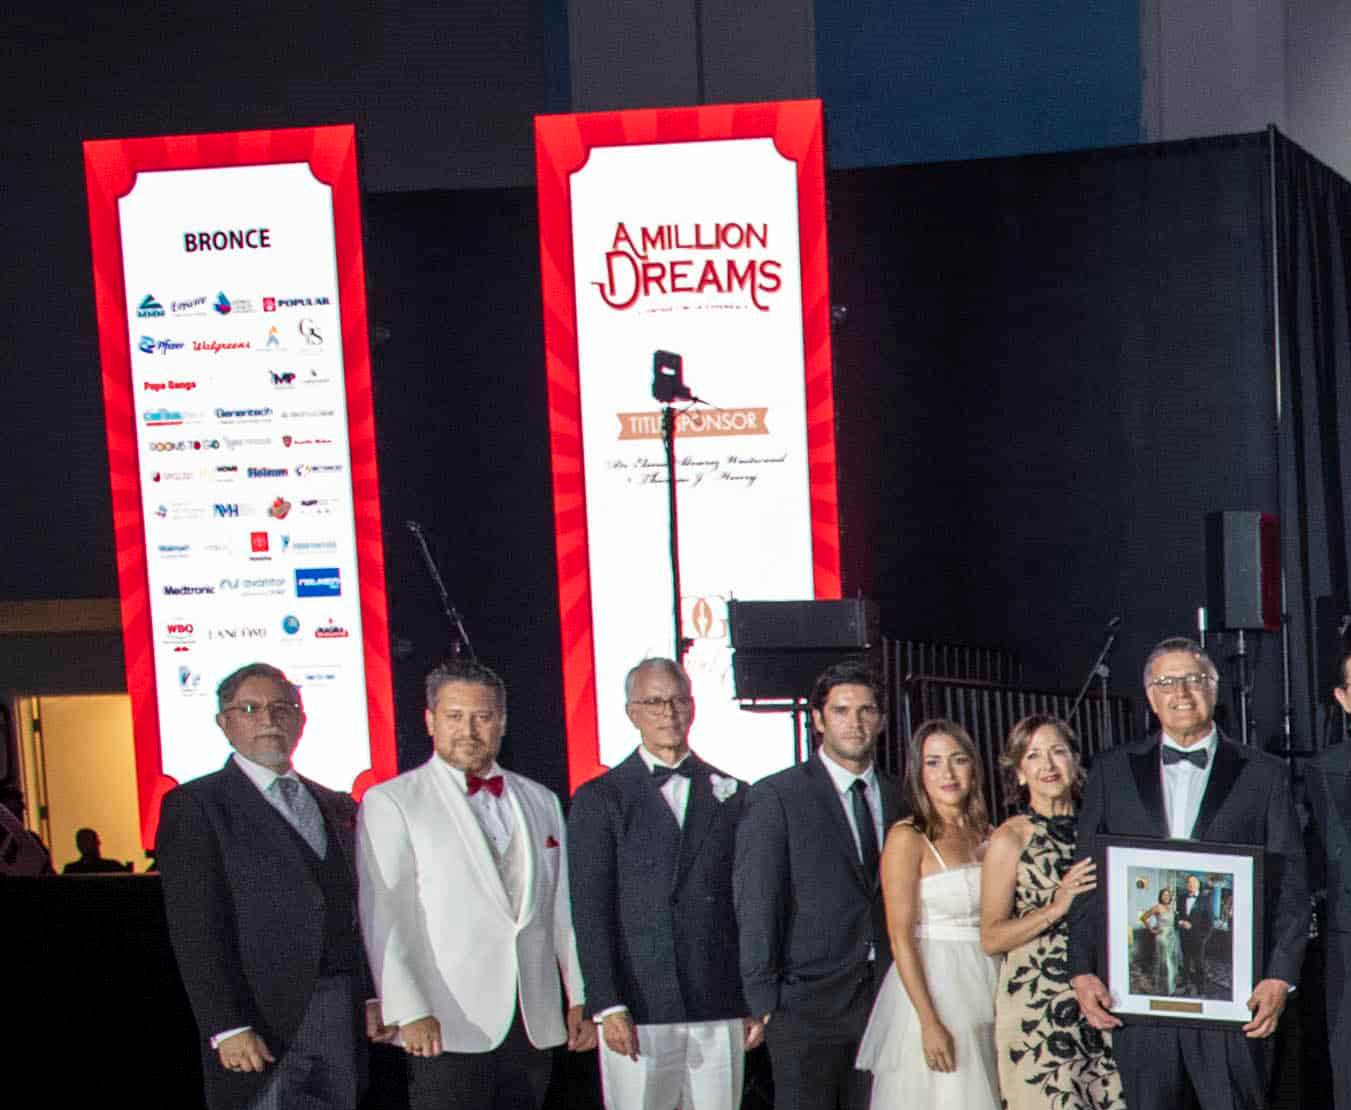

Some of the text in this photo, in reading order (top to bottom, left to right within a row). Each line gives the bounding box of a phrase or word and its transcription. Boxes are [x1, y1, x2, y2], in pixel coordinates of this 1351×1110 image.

[184, 228, 271, 252] BRONCE
[640, 222, 768, 252] MILLION
[591, 250, 782, 312] DREAMS
[278, 297, 330, 307] POPULAR
[193, 341, 250, 353] Walgreens
[163, 584, 216, 597] Medtronic
